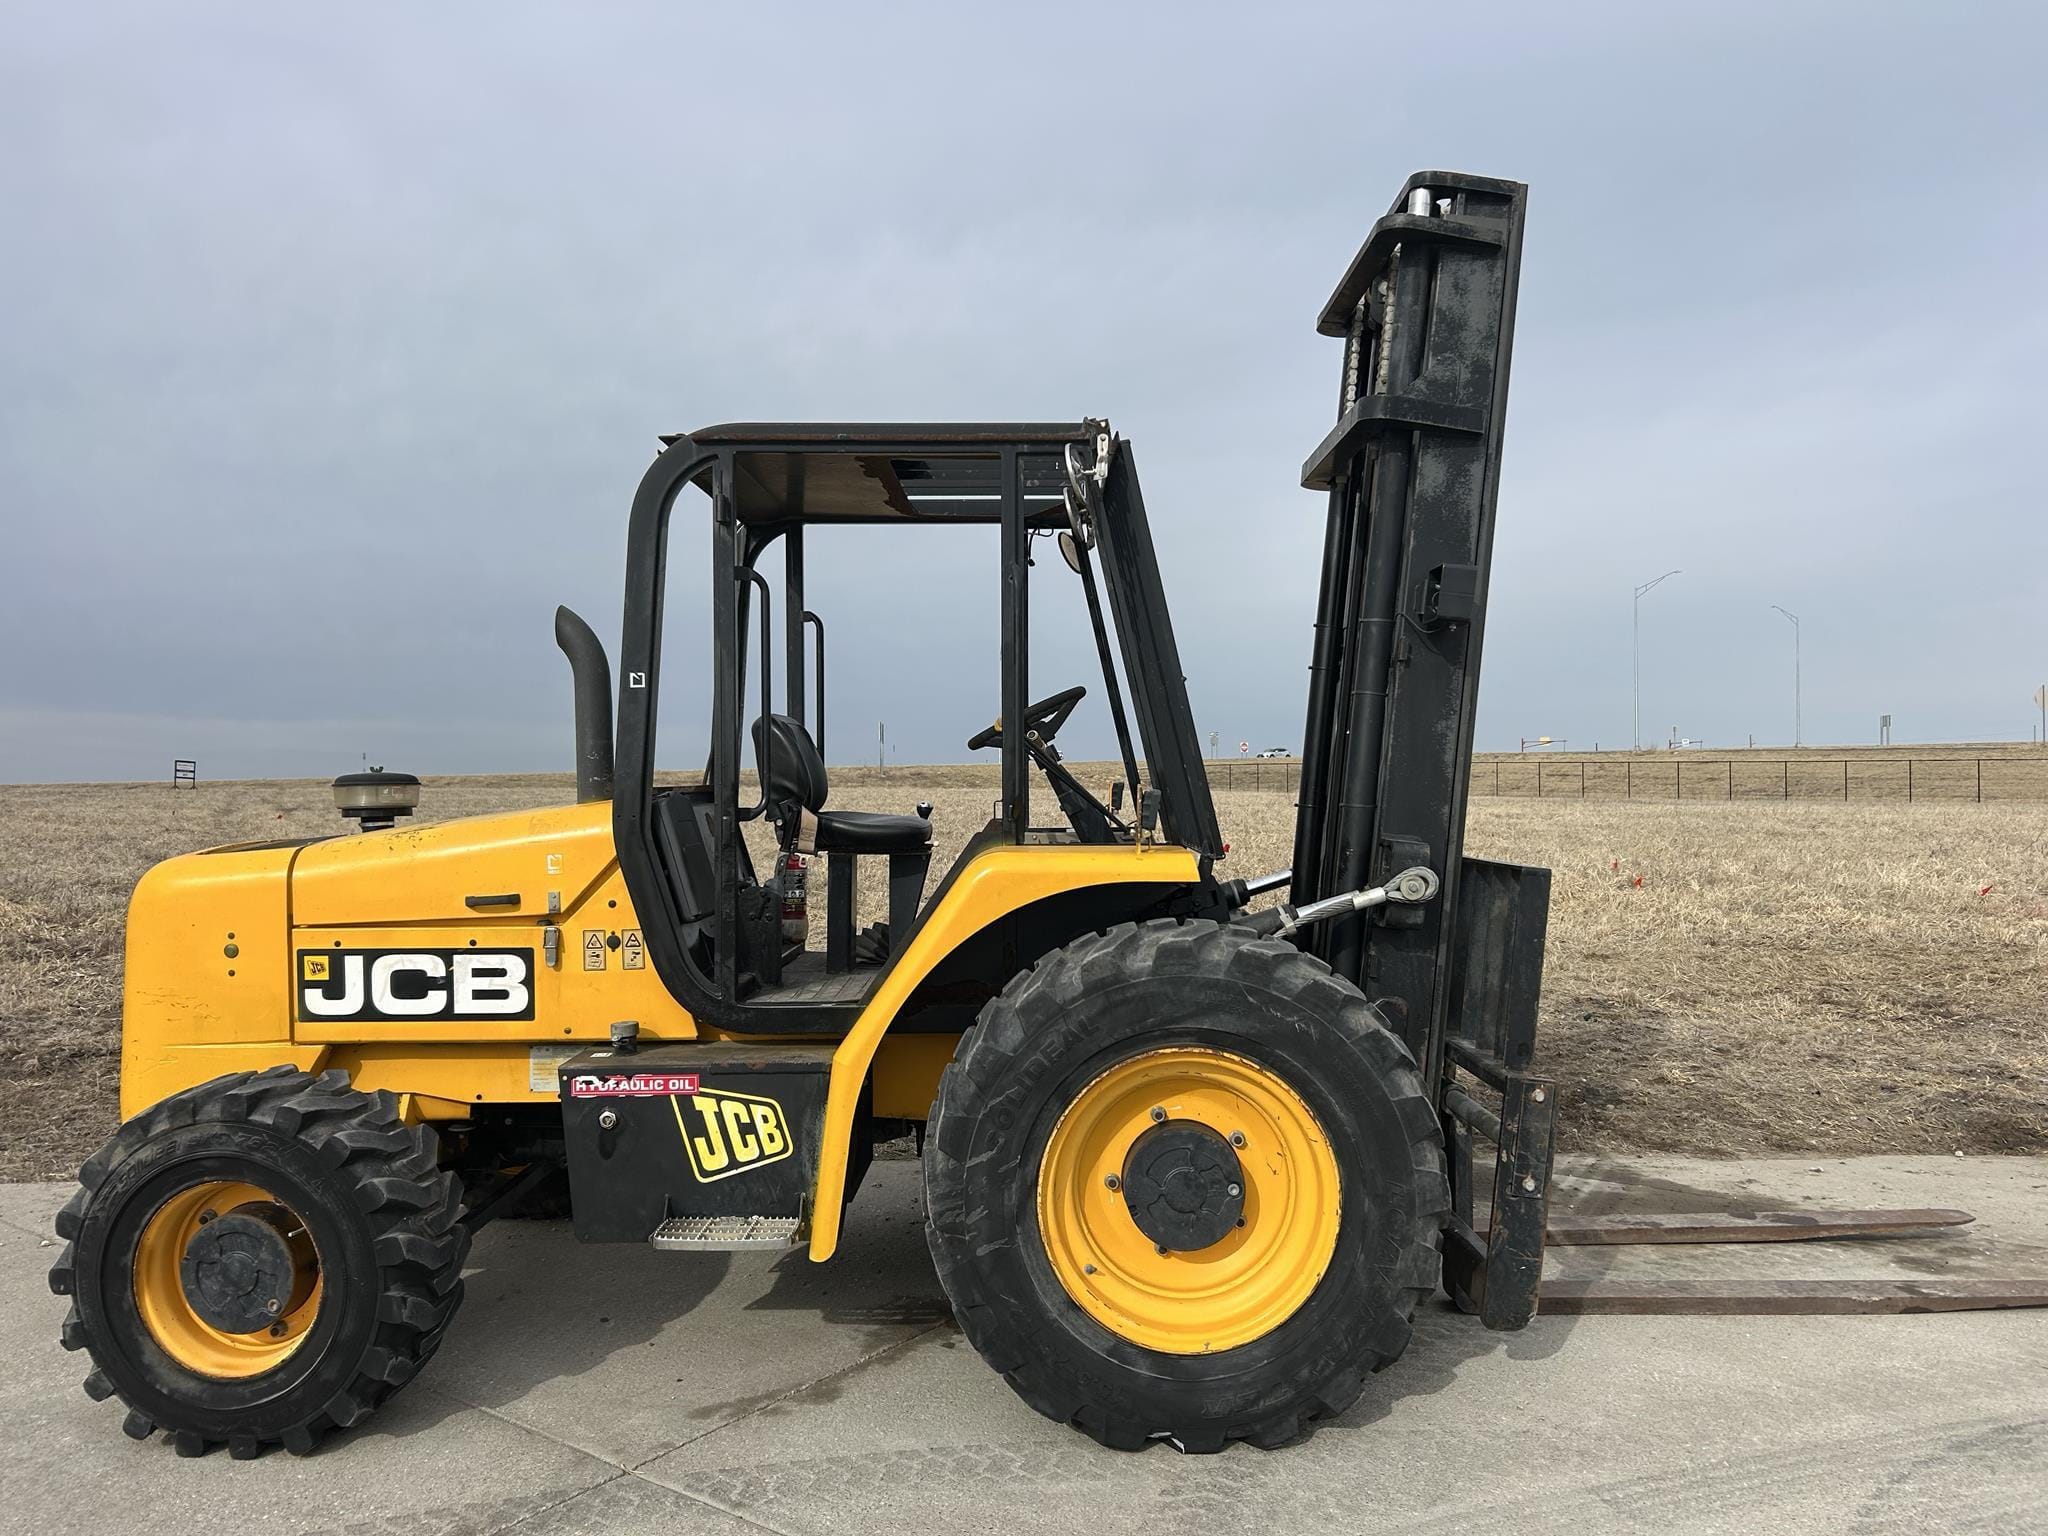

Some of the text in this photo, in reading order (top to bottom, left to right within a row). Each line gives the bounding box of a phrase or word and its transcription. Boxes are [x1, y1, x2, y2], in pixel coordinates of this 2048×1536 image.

[304, 953, 529, 1016] JCB
[668, 1079, 694, 1091] OIL
[691, 1095, 785, 1172] JCB
